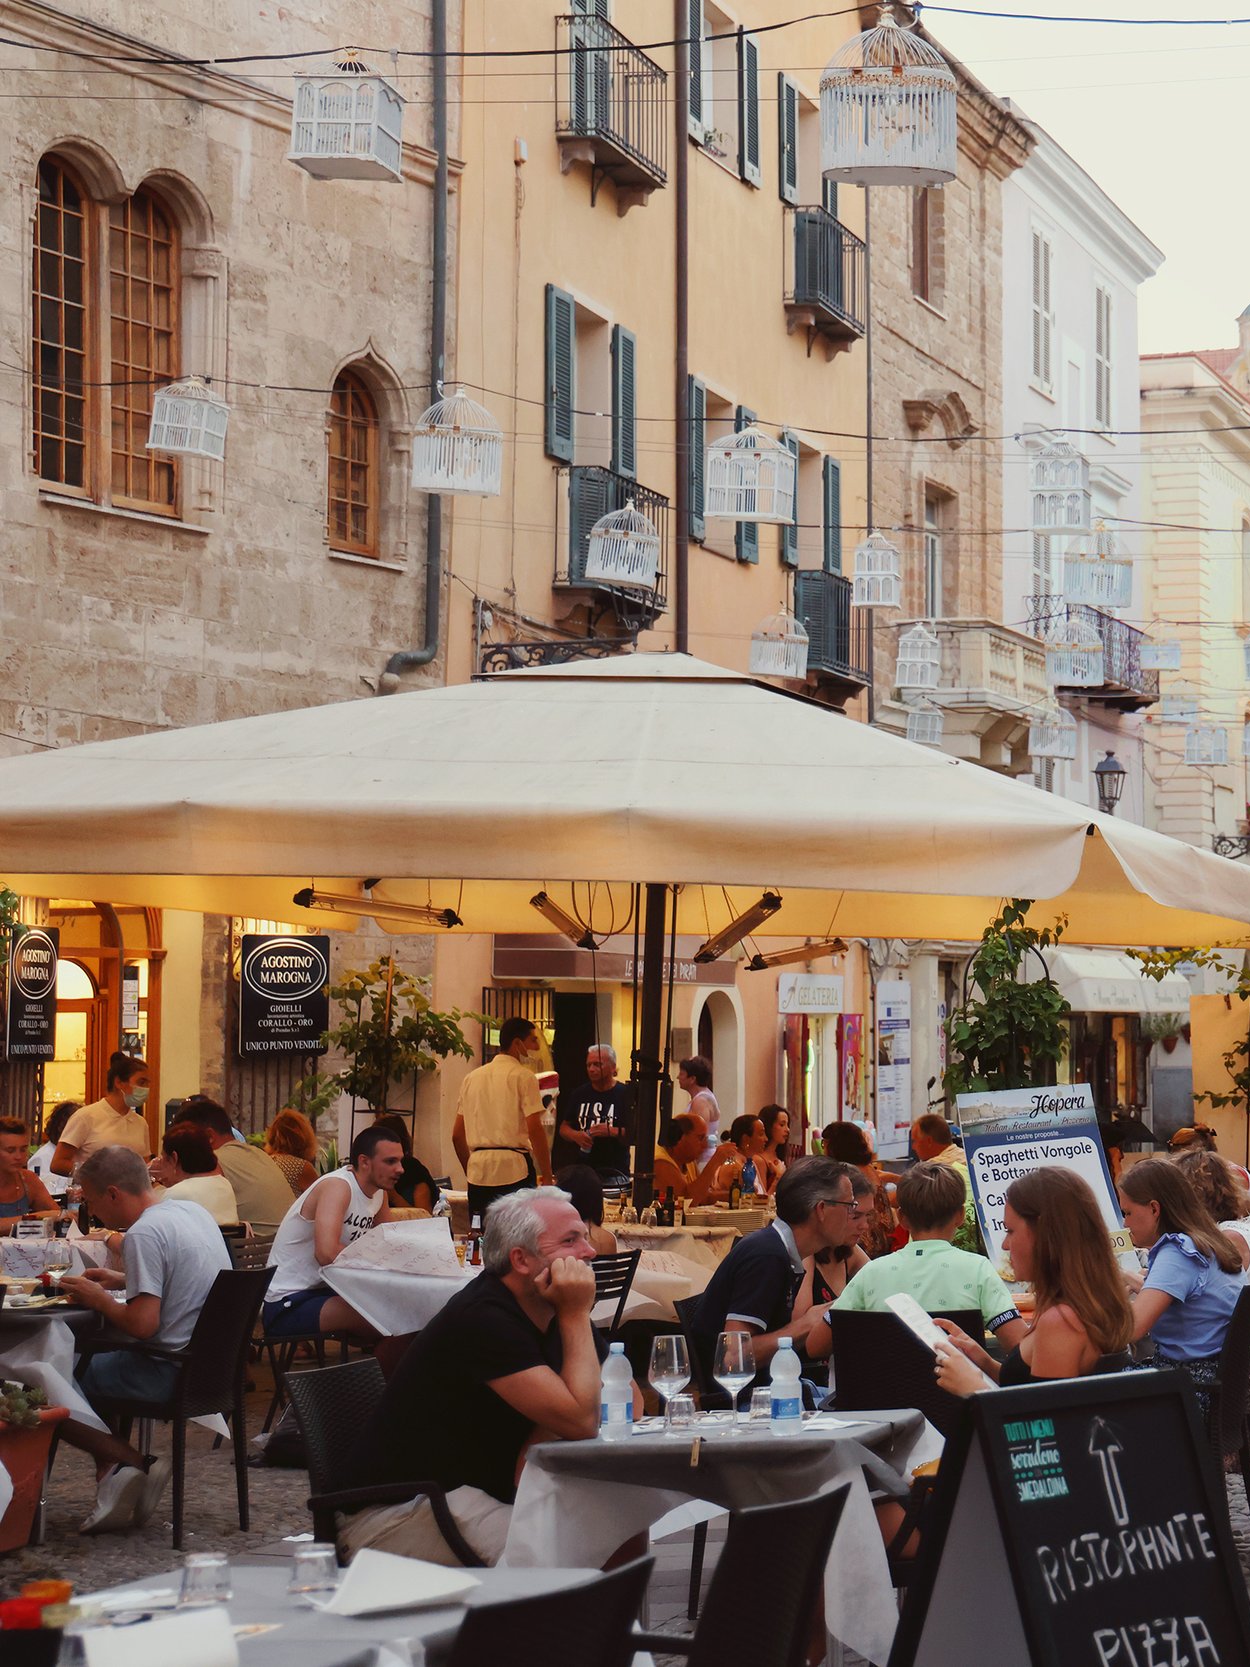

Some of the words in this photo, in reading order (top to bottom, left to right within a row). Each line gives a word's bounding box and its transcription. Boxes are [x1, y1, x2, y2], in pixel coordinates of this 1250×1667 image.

[22, 949, 50, 963] AGOSTINO
[260, 955, 313, 969] AGOSTINO
[21, 966, 49, 980] MAROGNA
[260, 971, 312, 984] MAROGNA
[799, 986, 839, 1006] GELATERIA
[270, 1004, 302, 1013] GIOIELLI
[258, 1019, 293, 1028] CORALLO
[297, 1018, 313, 1027] ORO
[245, 1041, 269, 1051] UNICO
[269, 1040, 294, 1051] PUNTO
[295, 1039, 324, 1050] VENDIT
[1029, 1094, 1085, 1119] Hopera
[1006, 1134, 1015, 1142] Le
[1015, 1133, 1034, 1141] nostre
[977, 1146, 1039, 1167] Spaghetti
[1040, 1142, 1092, 1159] Vongole
[981, 1172, 989, 1183] e
[1003, 1421, 1026, 1442] TUTTI
[1016, 1475, 1070, 1502] SMERALDINA
[1036, 1512, 1216, 1605] RISTORANTE
[1092, 1616, 1221, 1667] PIZZA
